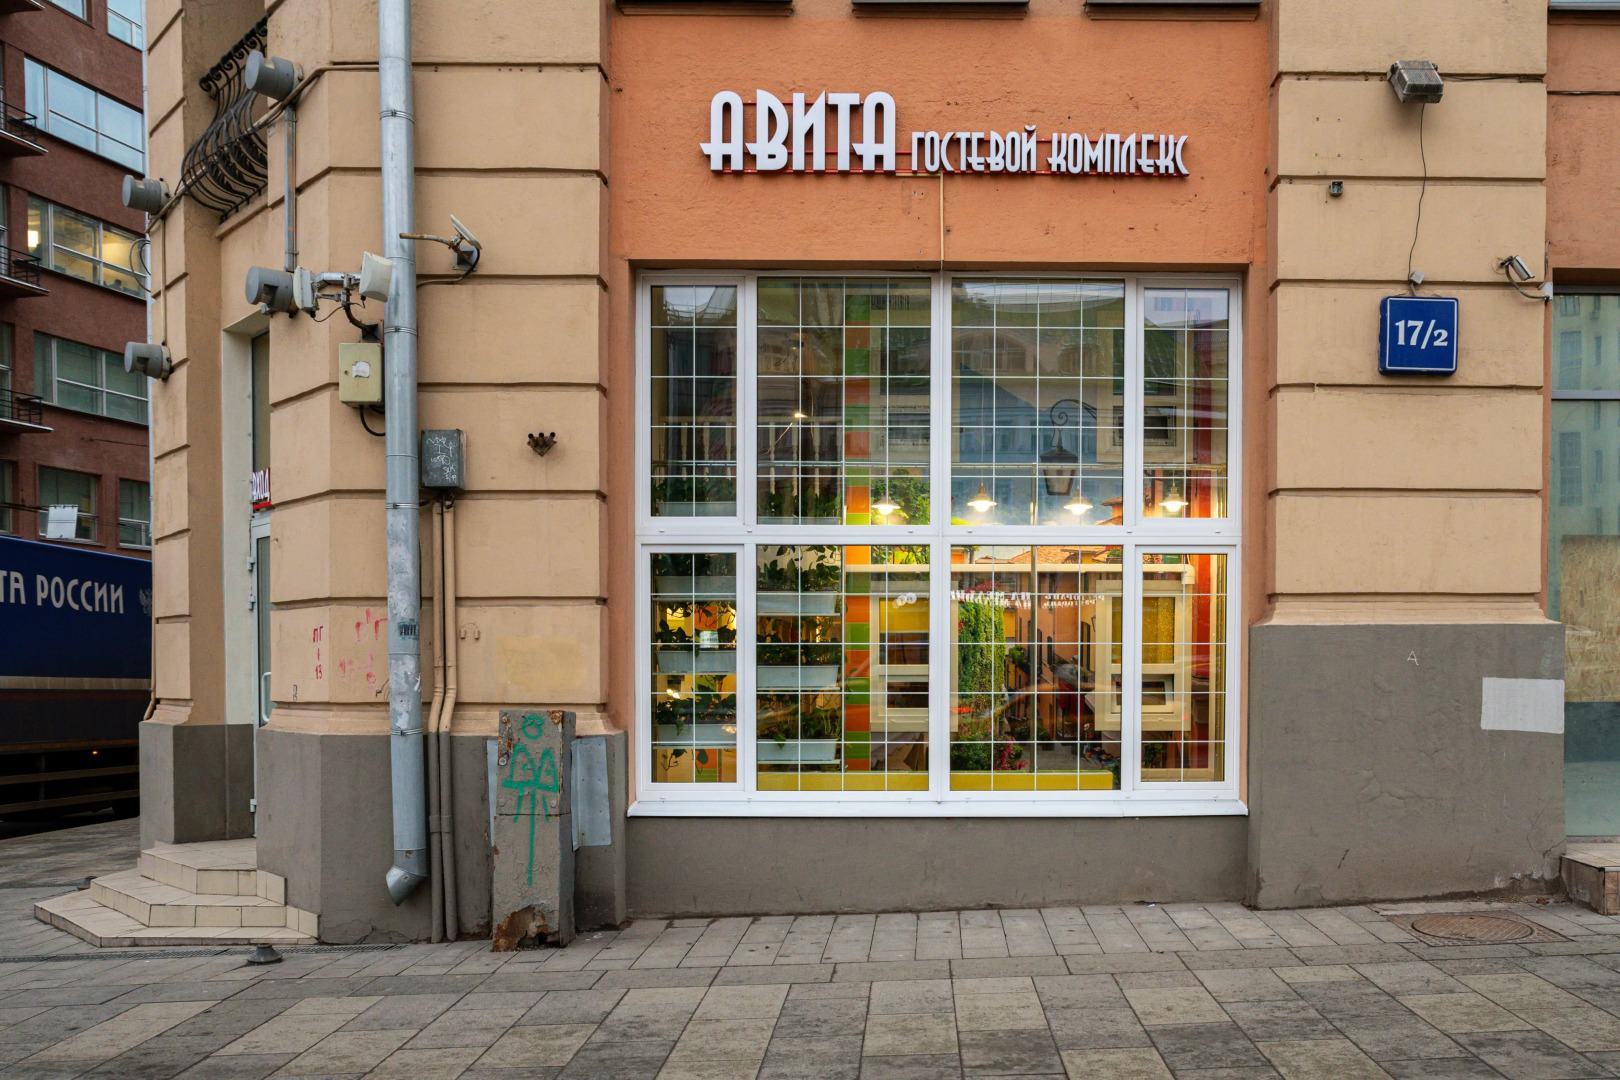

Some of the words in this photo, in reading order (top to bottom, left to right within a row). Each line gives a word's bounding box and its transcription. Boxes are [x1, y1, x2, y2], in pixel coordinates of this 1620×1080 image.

[699, 89, 897, 173] АВИТА
[911, 124, 1037, 174] ГОСТЕВОЙ
[1046, 132, 1191, 177] КОМПЛЕКС
[1395, 319, 1448, 349] 17/2
[36, 574, 124, 614] РОССИИ
